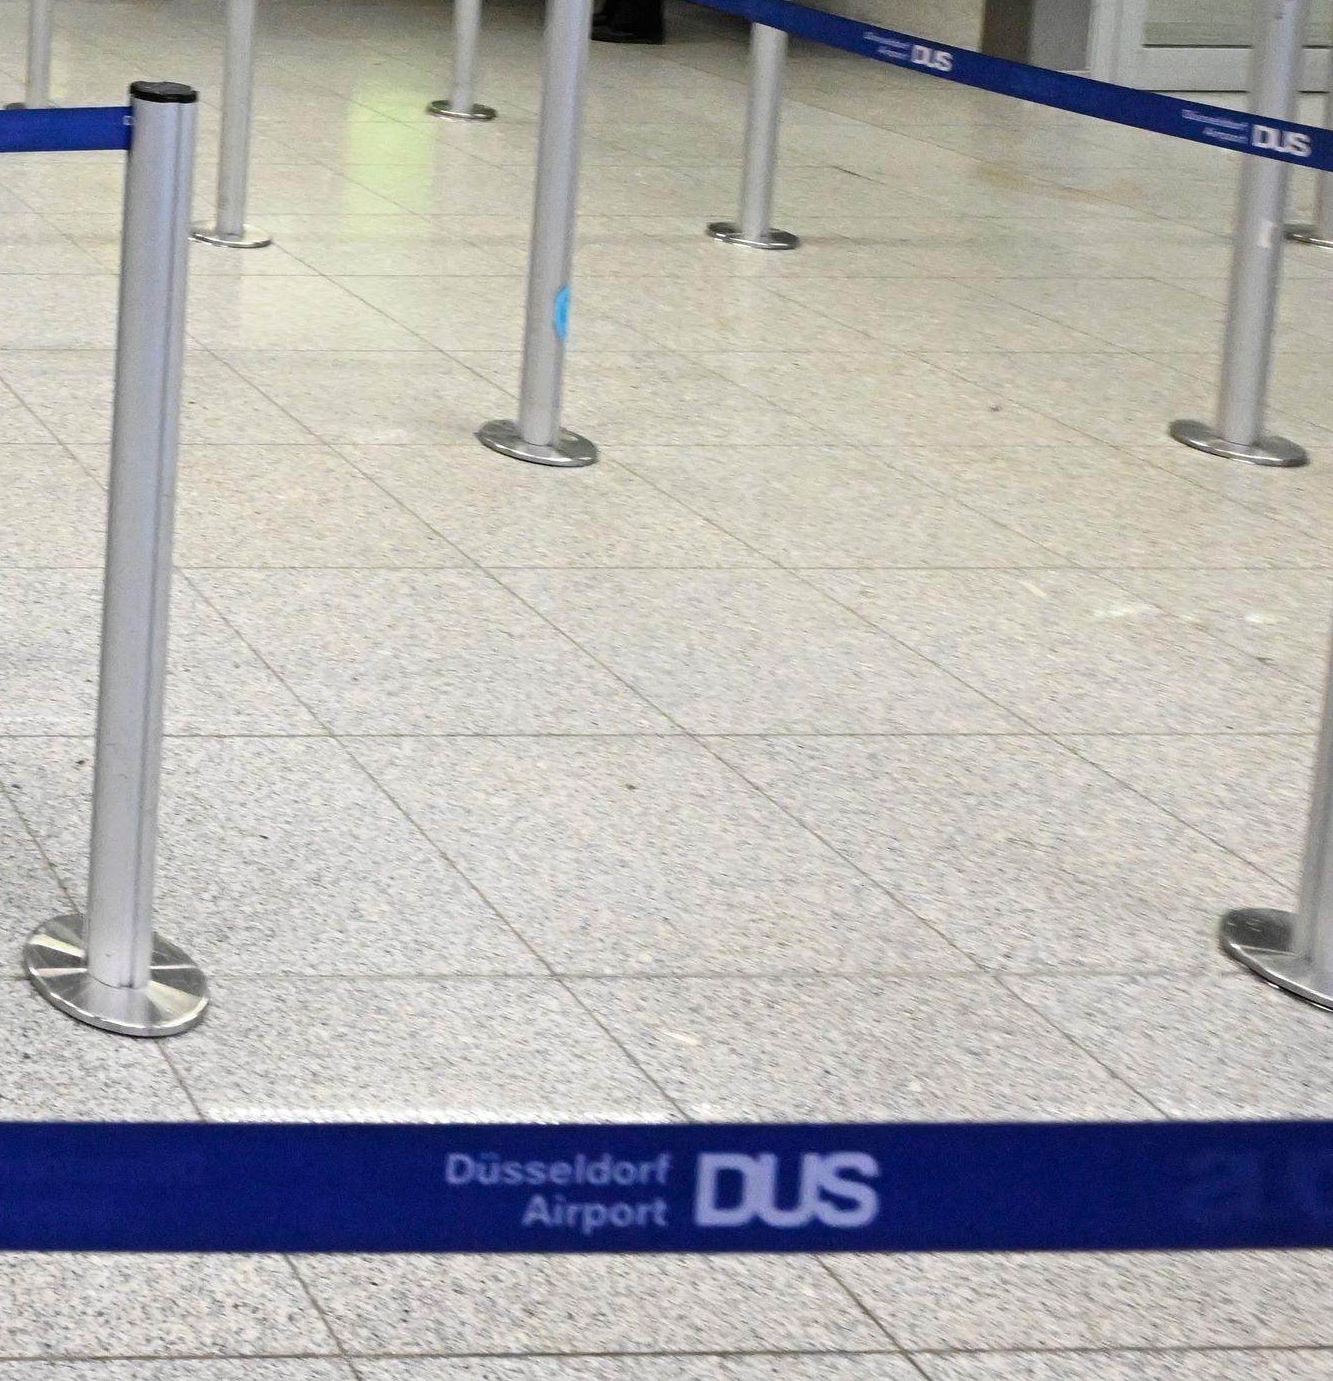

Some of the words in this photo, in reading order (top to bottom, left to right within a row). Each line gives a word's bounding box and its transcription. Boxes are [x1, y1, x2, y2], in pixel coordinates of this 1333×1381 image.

[910, 44, 954, 72] DUS
[1252, 124, 1313, 157] DUS
[444, 1150, 671, 1186] Düsseldorf
[694, 1151, 882, 1227] DUS
[522, 1193, 669, 1236] Airport
